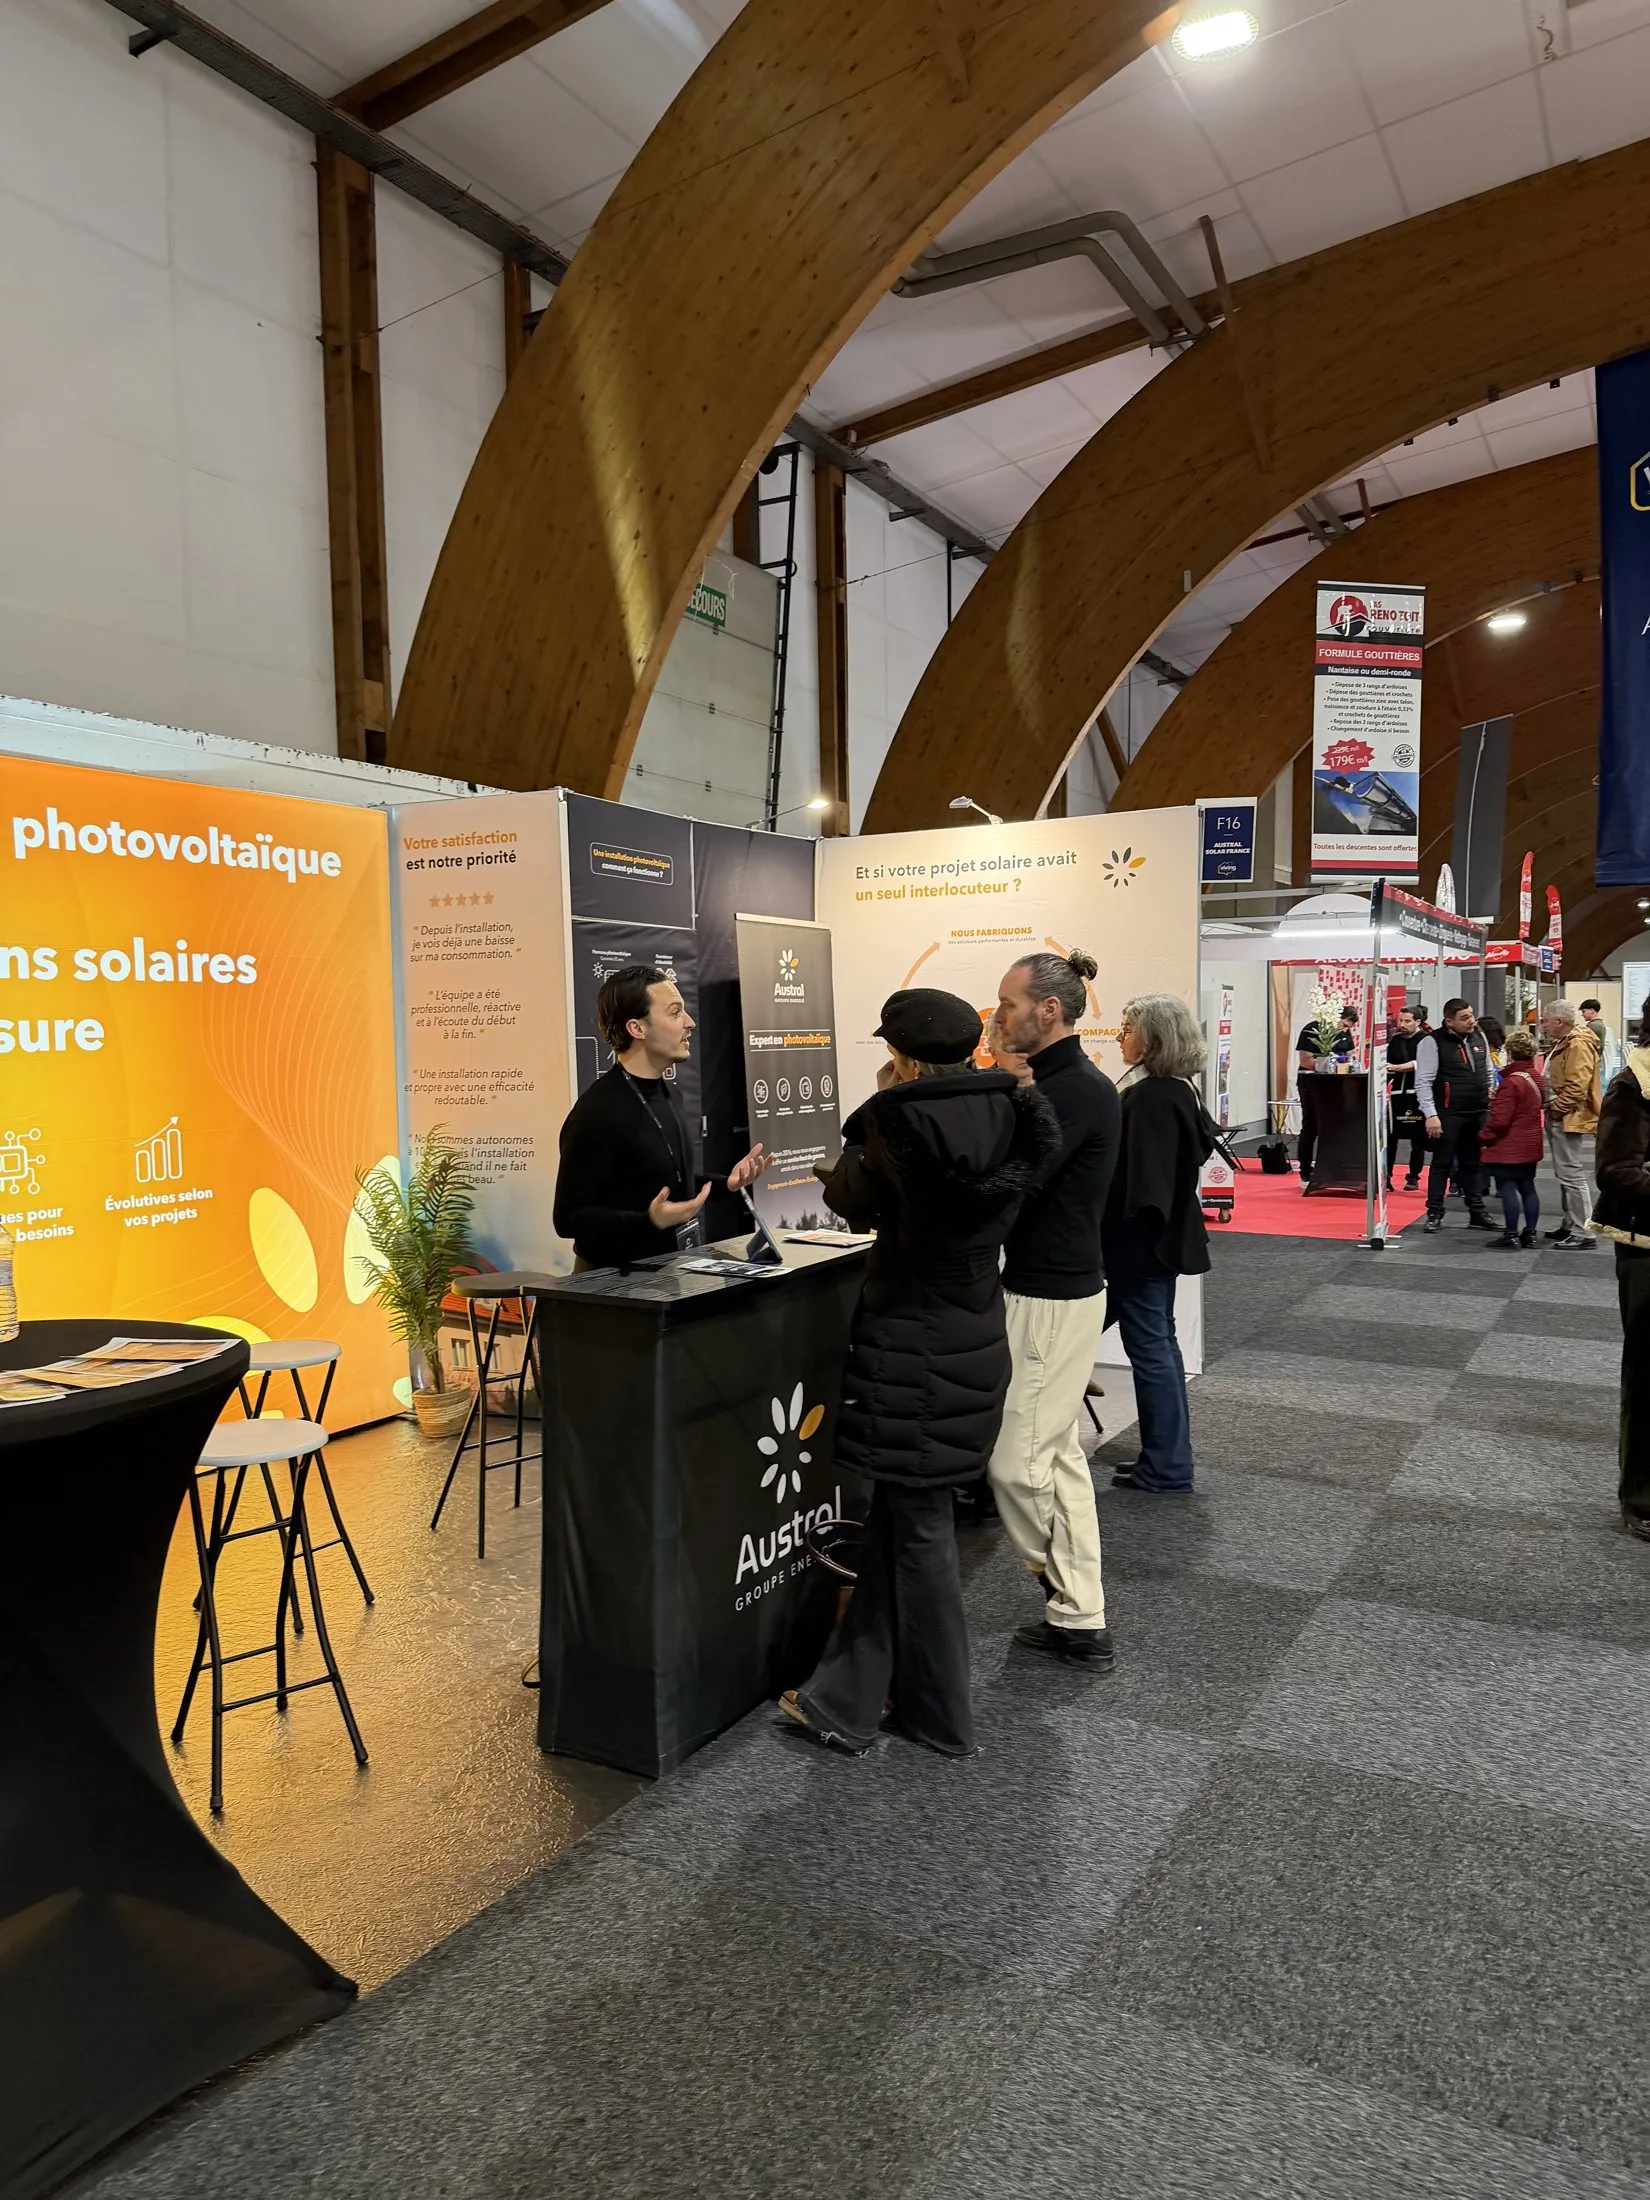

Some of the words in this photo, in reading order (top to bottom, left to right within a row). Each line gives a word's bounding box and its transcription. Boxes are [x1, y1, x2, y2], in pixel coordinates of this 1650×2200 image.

[687, 588, 725, 620] ECOURS
[1371, 609, 1397, 620] RENO
[1319, 648, 1363, 658] FORMULE
[1364, 650, 1420, 661] GOUTTIÈRES
[1327, 666, 1359, 675] Nantaise
[1371, 668, 1412, 676] demi-ronde
[1329, 754, 1355, 767] 179€
[1217, 817, 1241, 830] F16
[13, 807, 342, 883] photovoltaïque
[403, 837, 438, 850] Votre
[441, 830, 518, 847] satisfaction
[406, 858, 425, 870] est
[428, 856, 463, 868] notre
[466, 850, 517, 870] priorité
[593, 849, 605, 858] Une
[856, 867, 870, 879] Et
[873, 864, 884, 878] si
[888, 864, 926, 877] votre
[930, 859, 976, 878] projet
[980, 855, 1032, 872] solaire
[1037, 850, 1077, 867] avait
[856, 890, 873, 901] un
[877, 885, 906, 900] seul
[910, 881, 1009, 898] interlocuteur
[1013, 878, 1022, 892] ?
[420, 925, 453, 937] Depuis
[455, 922, 514, 934] l'installation,
[976, 927, 1032, 936] FABRIQUONS
[412, 940, 421, 951] je
[423, 939, 440, 948] vois
[442, 936, 462, 949] déjà
[465, 938, 483, 947] une
[485, 935, 515, 945] baisse
[73, 937, 257, 984] solaires
[441, 948, 513, 960] consommation.
[435, 990, 475, 1002] L'équipe
[477, 991, 483, 999] a
[485, 988, 501, 999] été
[774, 982, 805, 996] Austral
[410, 1003, 481, 1016] professionnelle,
[483, 1001, 521, 1012] réactive
[416, 1017, 425, 1027] et
[426, 1017, 432, 1027] à
[433, 1016, 469, 1027] l'écoute
[471, 1015, 484, 1026] du
[486, 1014, 516, 1026] début
[443, 1029, 449, 1039] à
[451, 1028, 459, 1039] la
[461, 1028, 476, 1039] fin.
[749, 1034, 773, 1048] Expert
[774, 1037, 783, 1045] en
[783, 1033, 831, 1048] photovoltaïque
[420, 1069, 437, 1079] Une
[438, 1068, 489, 1078] installation
[491, 1068, 524, 1081] rapide
[404, 1083, 413, 1092] et
[414, 1084, 443, 1094] propre
[444, 1083, 465, 1092] avec
[467, 1083, 486, 1092] une
[488, 1081, 535, 1092] efficacité
[434, 1095, 488, 1105] redoutable.
[475, 1135, 534, 1145] autonomes
[471, 1147, 535, 1158] l'installation
[485, 1161, 492, 1171] il
[494, 1163, 507, 1171] ne
[510, 1160, 527, 1171] fait
[468, 1174, 496, 1184] beau.
[104, 1193, 176, 1211] Évolutives
[178, 1188, 213, 1202] selon
[27, 1207, 63, 1225] pour
[124, 1215, 148, 1227] vos
[151, 1208, 198, 1227] projets
[16, 1224, 75, 1242] besoins
[735, 1485, 841, 1585] Austral
[735, 1570, 785, 1611] GROUPE
